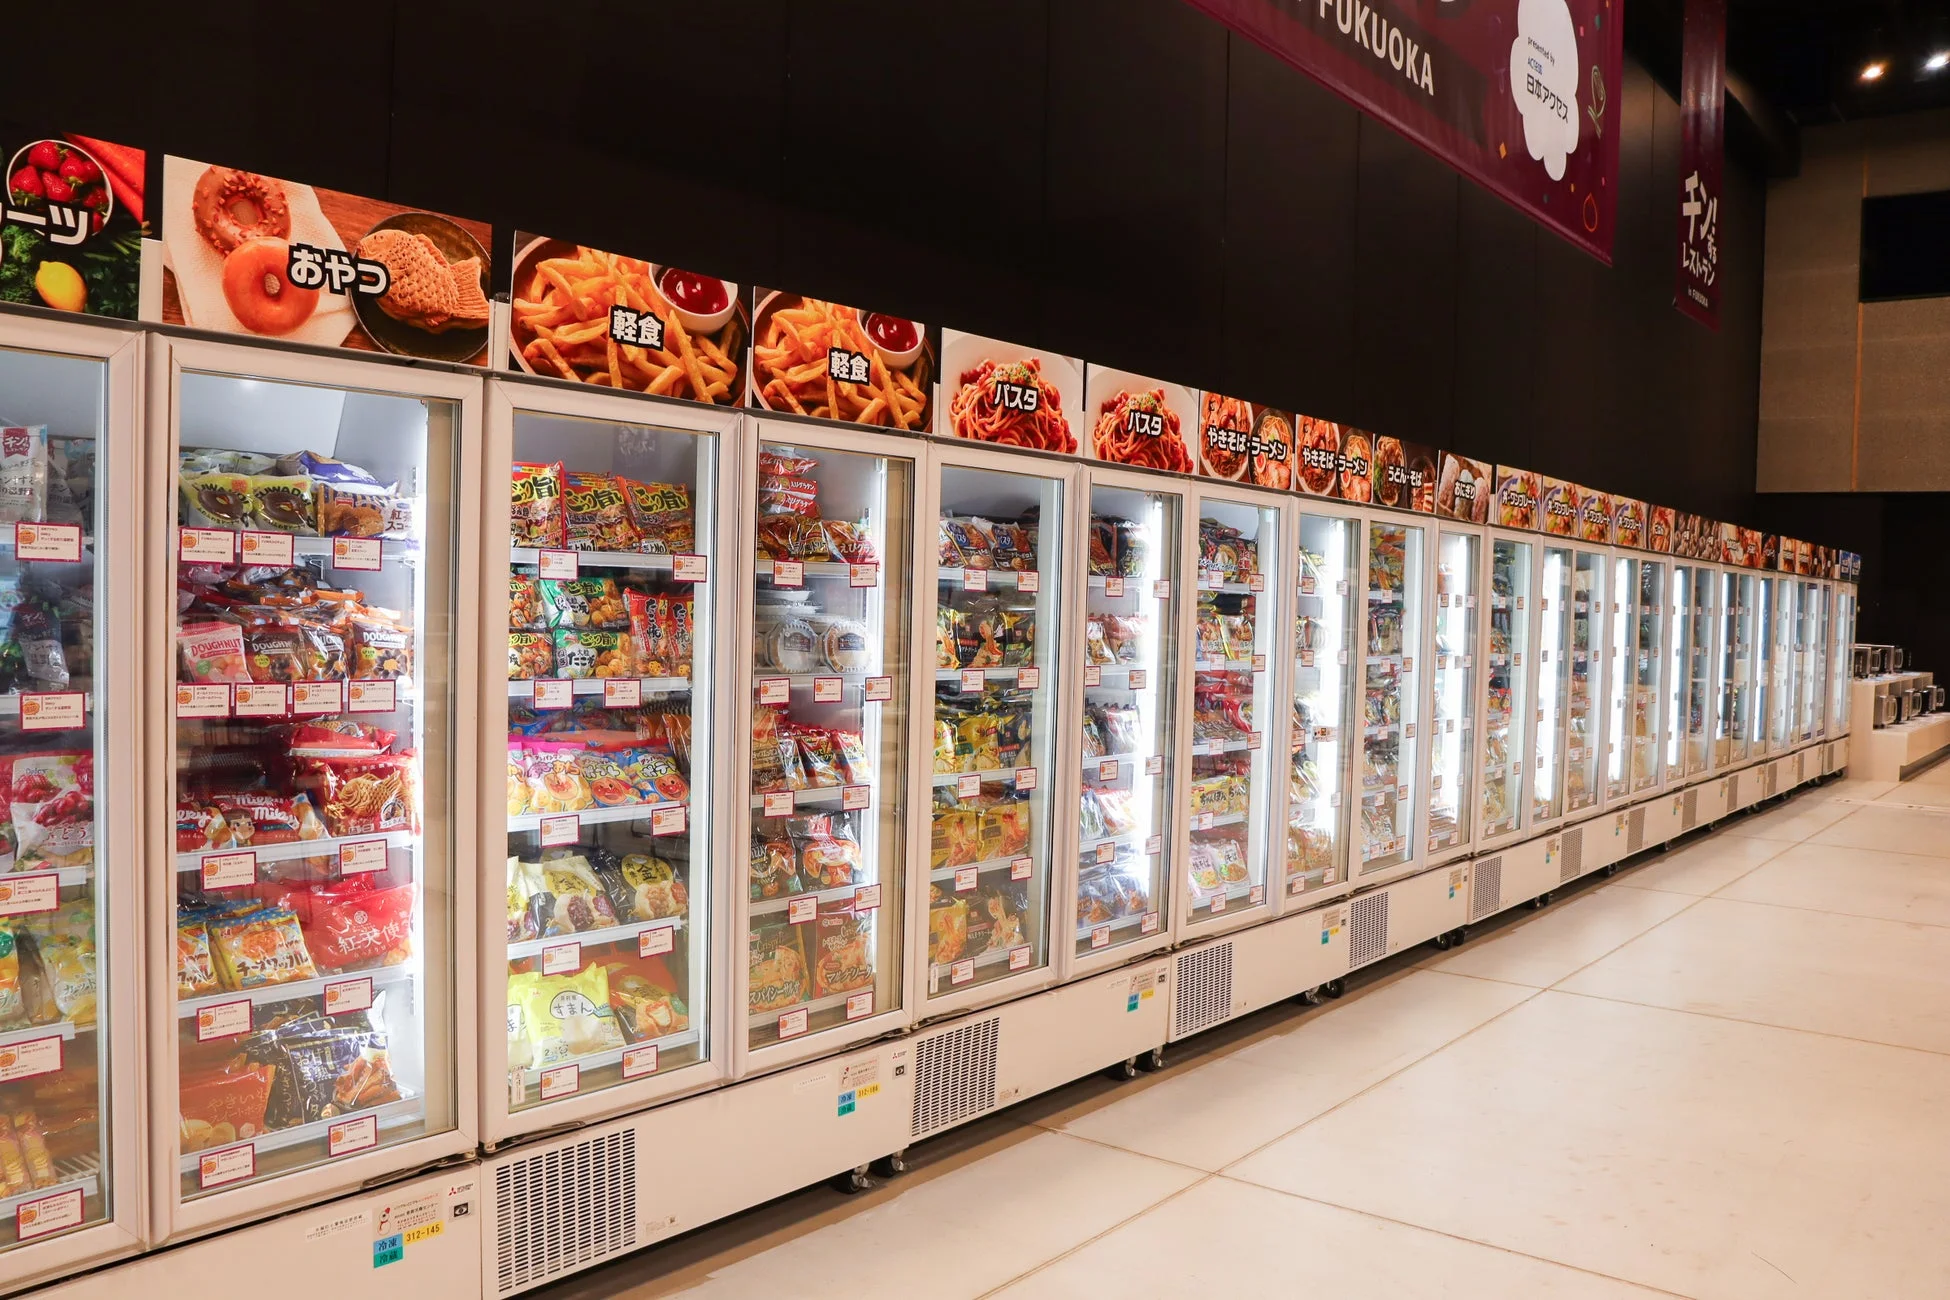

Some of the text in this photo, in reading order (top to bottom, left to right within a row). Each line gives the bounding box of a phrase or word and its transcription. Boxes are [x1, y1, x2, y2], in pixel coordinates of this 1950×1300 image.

[1526, 73, 1569, 124] 日本アクセス
[290, 247, 388, 294] おやつ
[1682, 242, 1716, 287] レストラン
[611, 308, 665, 348] 軽食
[830, 350, 870, 383] 軽食
[994, 383, 1038, 412] パスタ
[1128, 411, 1162, 436] パスタ
[1207, 427, 1287, 461] やきそば・ラーメン
[1303, 448, 1368, 477] やきそば・ラーメン
[1388, 466, 1422, 487] うどん・そば
[1454, 481, 1476, 500] おにぎり
[191, 637, 243, 657] DOUGHNUT
[236, 953, 309, 977] チーズワッフル
[377, 1239, 398, 1252] 冷凍
[405, 1224, 441, 1243] 312-145
[378, 1251, 398, 1264] 冷蔵
